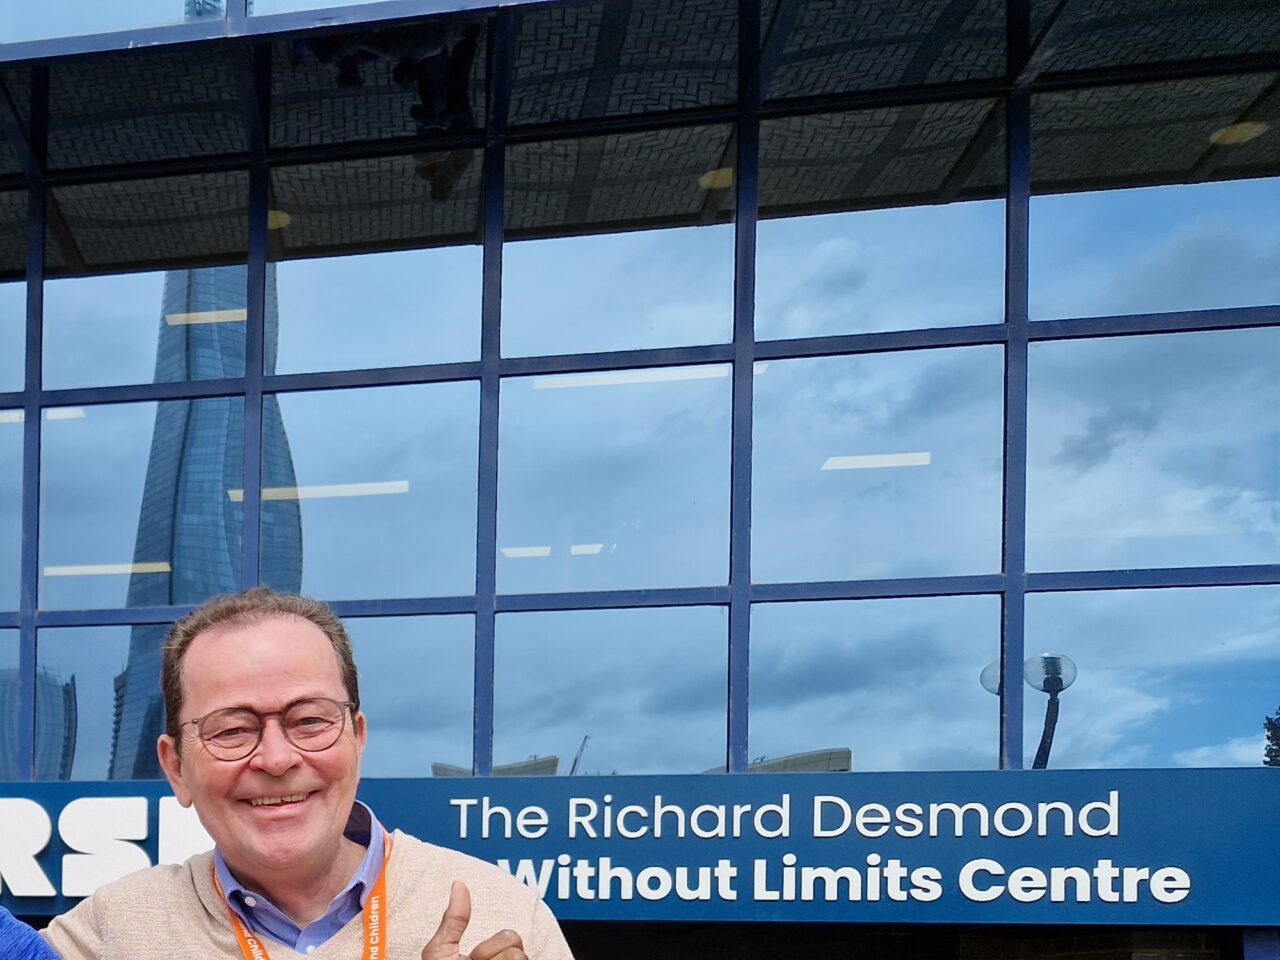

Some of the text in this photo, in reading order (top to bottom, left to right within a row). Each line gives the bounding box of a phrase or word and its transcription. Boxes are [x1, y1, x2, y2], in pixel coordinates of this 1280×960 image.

[450, 790, 1119, 839] The Richard Desmond
[753, 853, 943, 902] Limits
[959, 858, 1191, 903] Centre
[368, 895, 381, 943] Children
